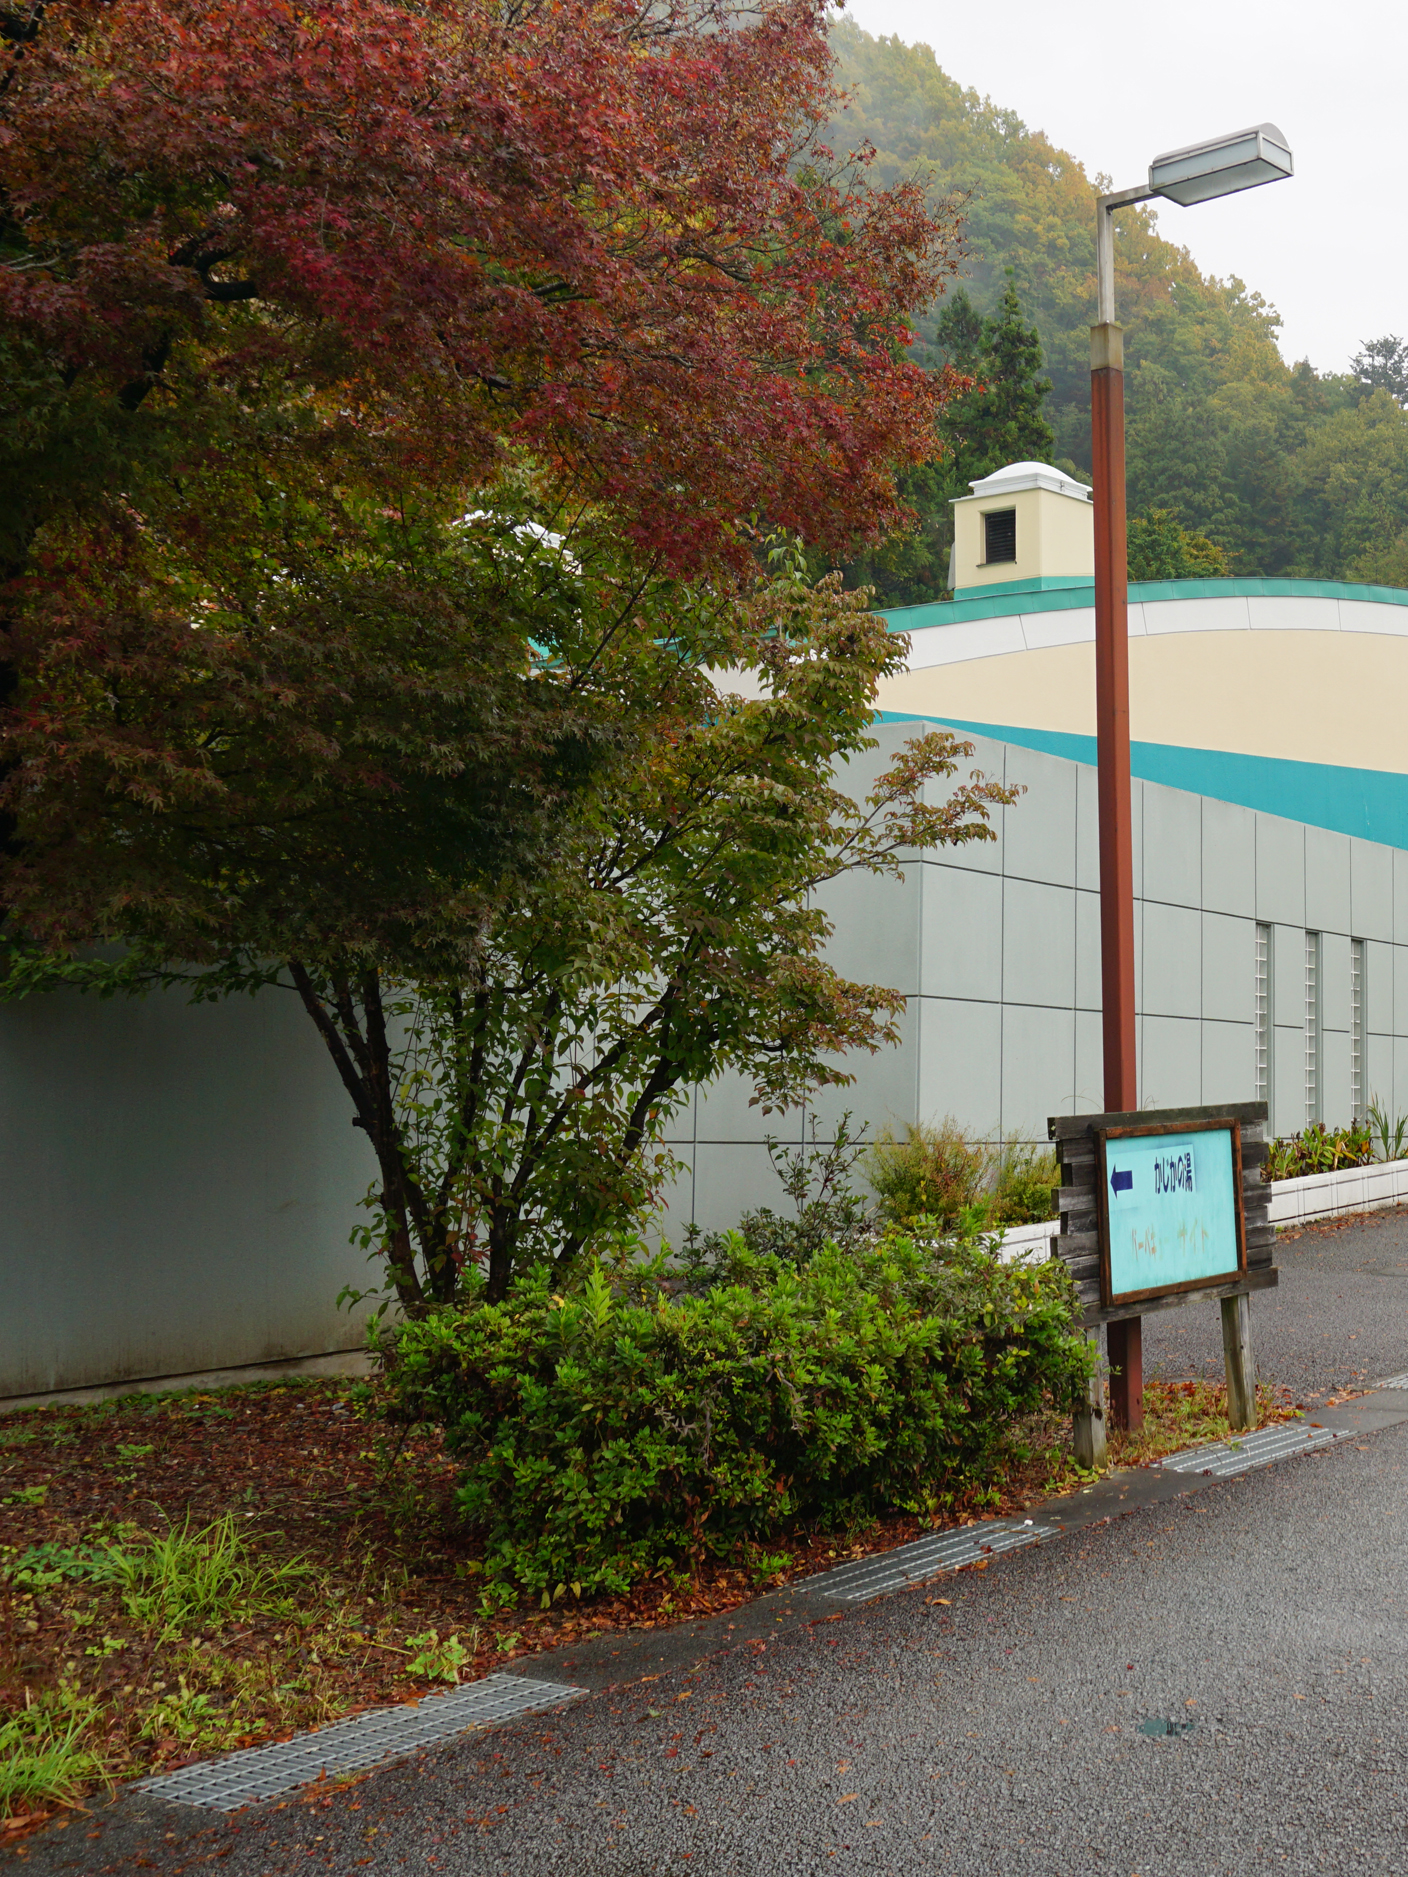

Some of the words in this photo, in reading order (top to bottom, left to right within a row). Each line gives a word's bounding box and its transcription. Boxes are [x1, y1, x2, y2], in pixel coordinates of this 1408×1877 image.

[1154, 1152, 1193, 1194] かじかの湯
